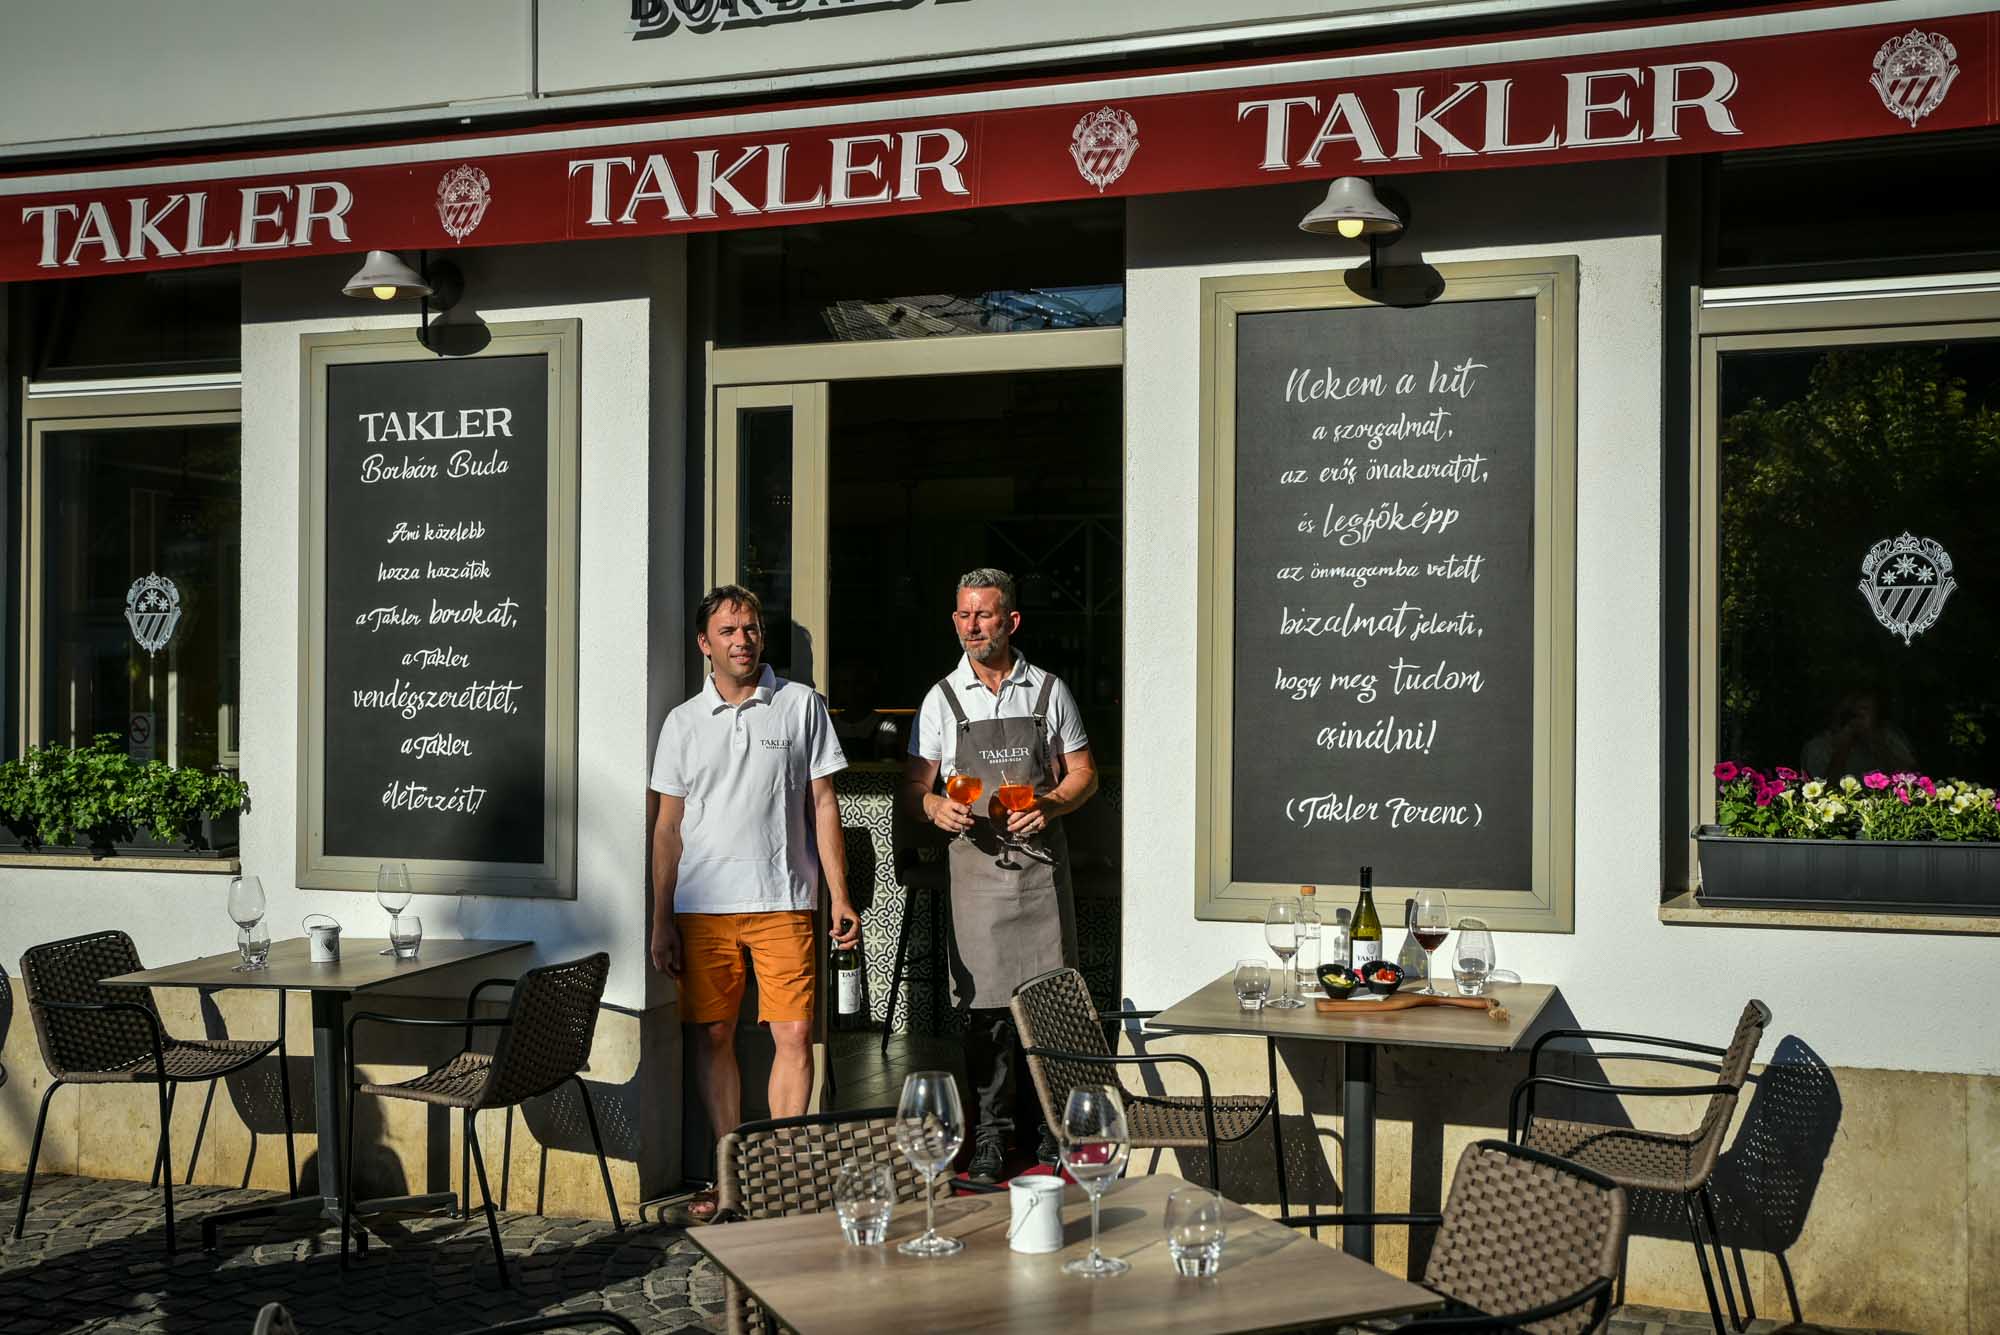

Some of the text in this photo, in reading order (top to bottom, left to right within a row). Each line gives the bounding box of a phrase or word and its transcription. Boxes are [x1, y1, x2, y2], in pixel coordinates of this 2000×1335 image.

[1236, 60, 1742, 170] TAKLER
[568, 127, 971, 228] TAKLER
[22, 181, 354, 268] TAKLER
[1286, 358, 1488, 402] Nekem a hit
[359, 408, 512, 442] TAKLER
[1312, 407, 1452, 450] a szorgalmat,
[361, 449, 508, 483] Borbár Buda
[1281, 470, 1308, 484] az
[1320, 458, 1357, 484] erős
[387, 521, 485, 543] Ami közelebb
[1298, 502, 1459, 546] és legfőképp
[378, 562, 420, 581] hozza
[1277, 554, 1485, 587] az önmagamba vetett
[356, 597, 519, 632] a Takler borokat,
[1280, 601, 1483, 641] bizalmat jelenti,
[402, 646, 470, 669] a Takler
[1275, 657, 1484, 703] hogy meg tudom
[354, 679, 523, 719] vendégszeretetet,
[401, 732, 472, 759] a Takler
[1317, 716, 1436, 754] csinálni!
[979, 747, 1030, 760] TAKLER
